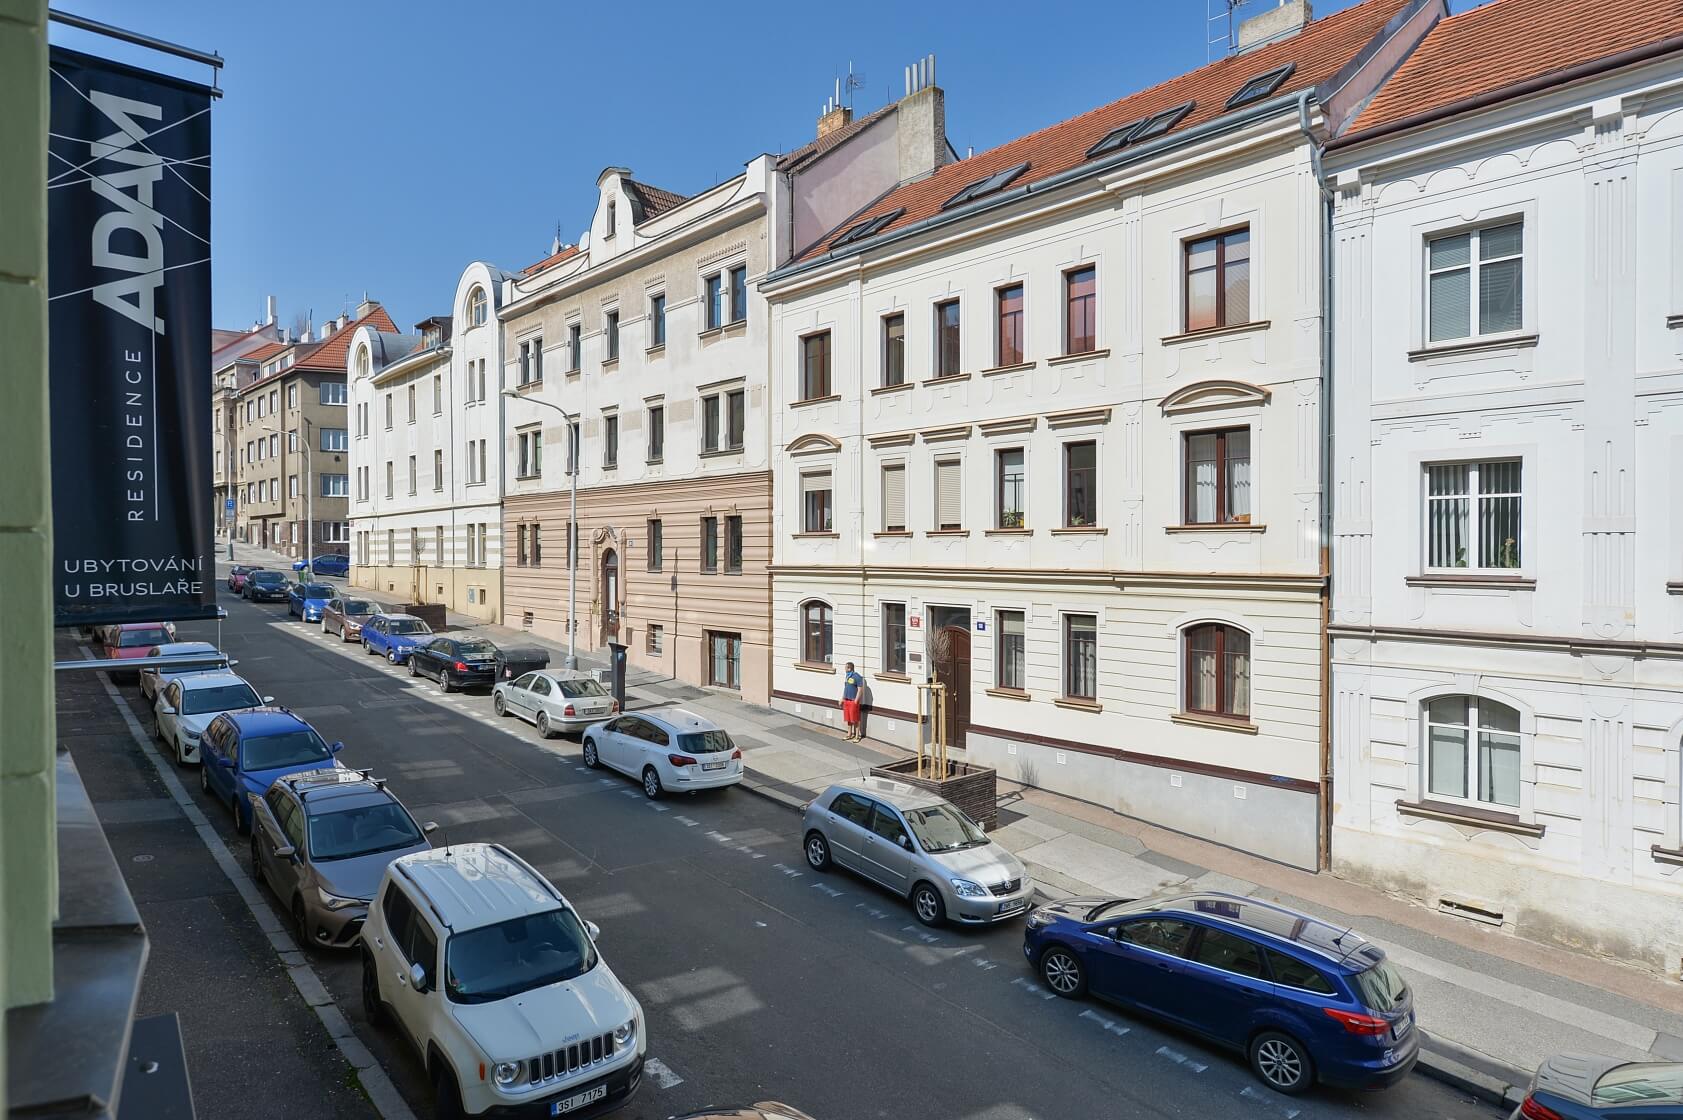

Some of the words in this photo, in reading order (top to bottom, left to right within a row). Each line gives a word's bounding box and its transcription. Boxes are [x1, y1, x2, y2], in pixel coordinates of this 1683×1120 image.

[90, 90, 165, 335] ADAM
[127, 349, 144, 521] RESIDENCE
[64, 555, 204, 573] UBYTOVÁNÍ
[65, 584, 80, 598] U
[89, 578, 204, 597] BRUSLAŘE
[562, 1033, 580, 1043] Jeep
[558, 1098, 574, 1112] 3SI
[581, 1088, 603, 1102] 7175
